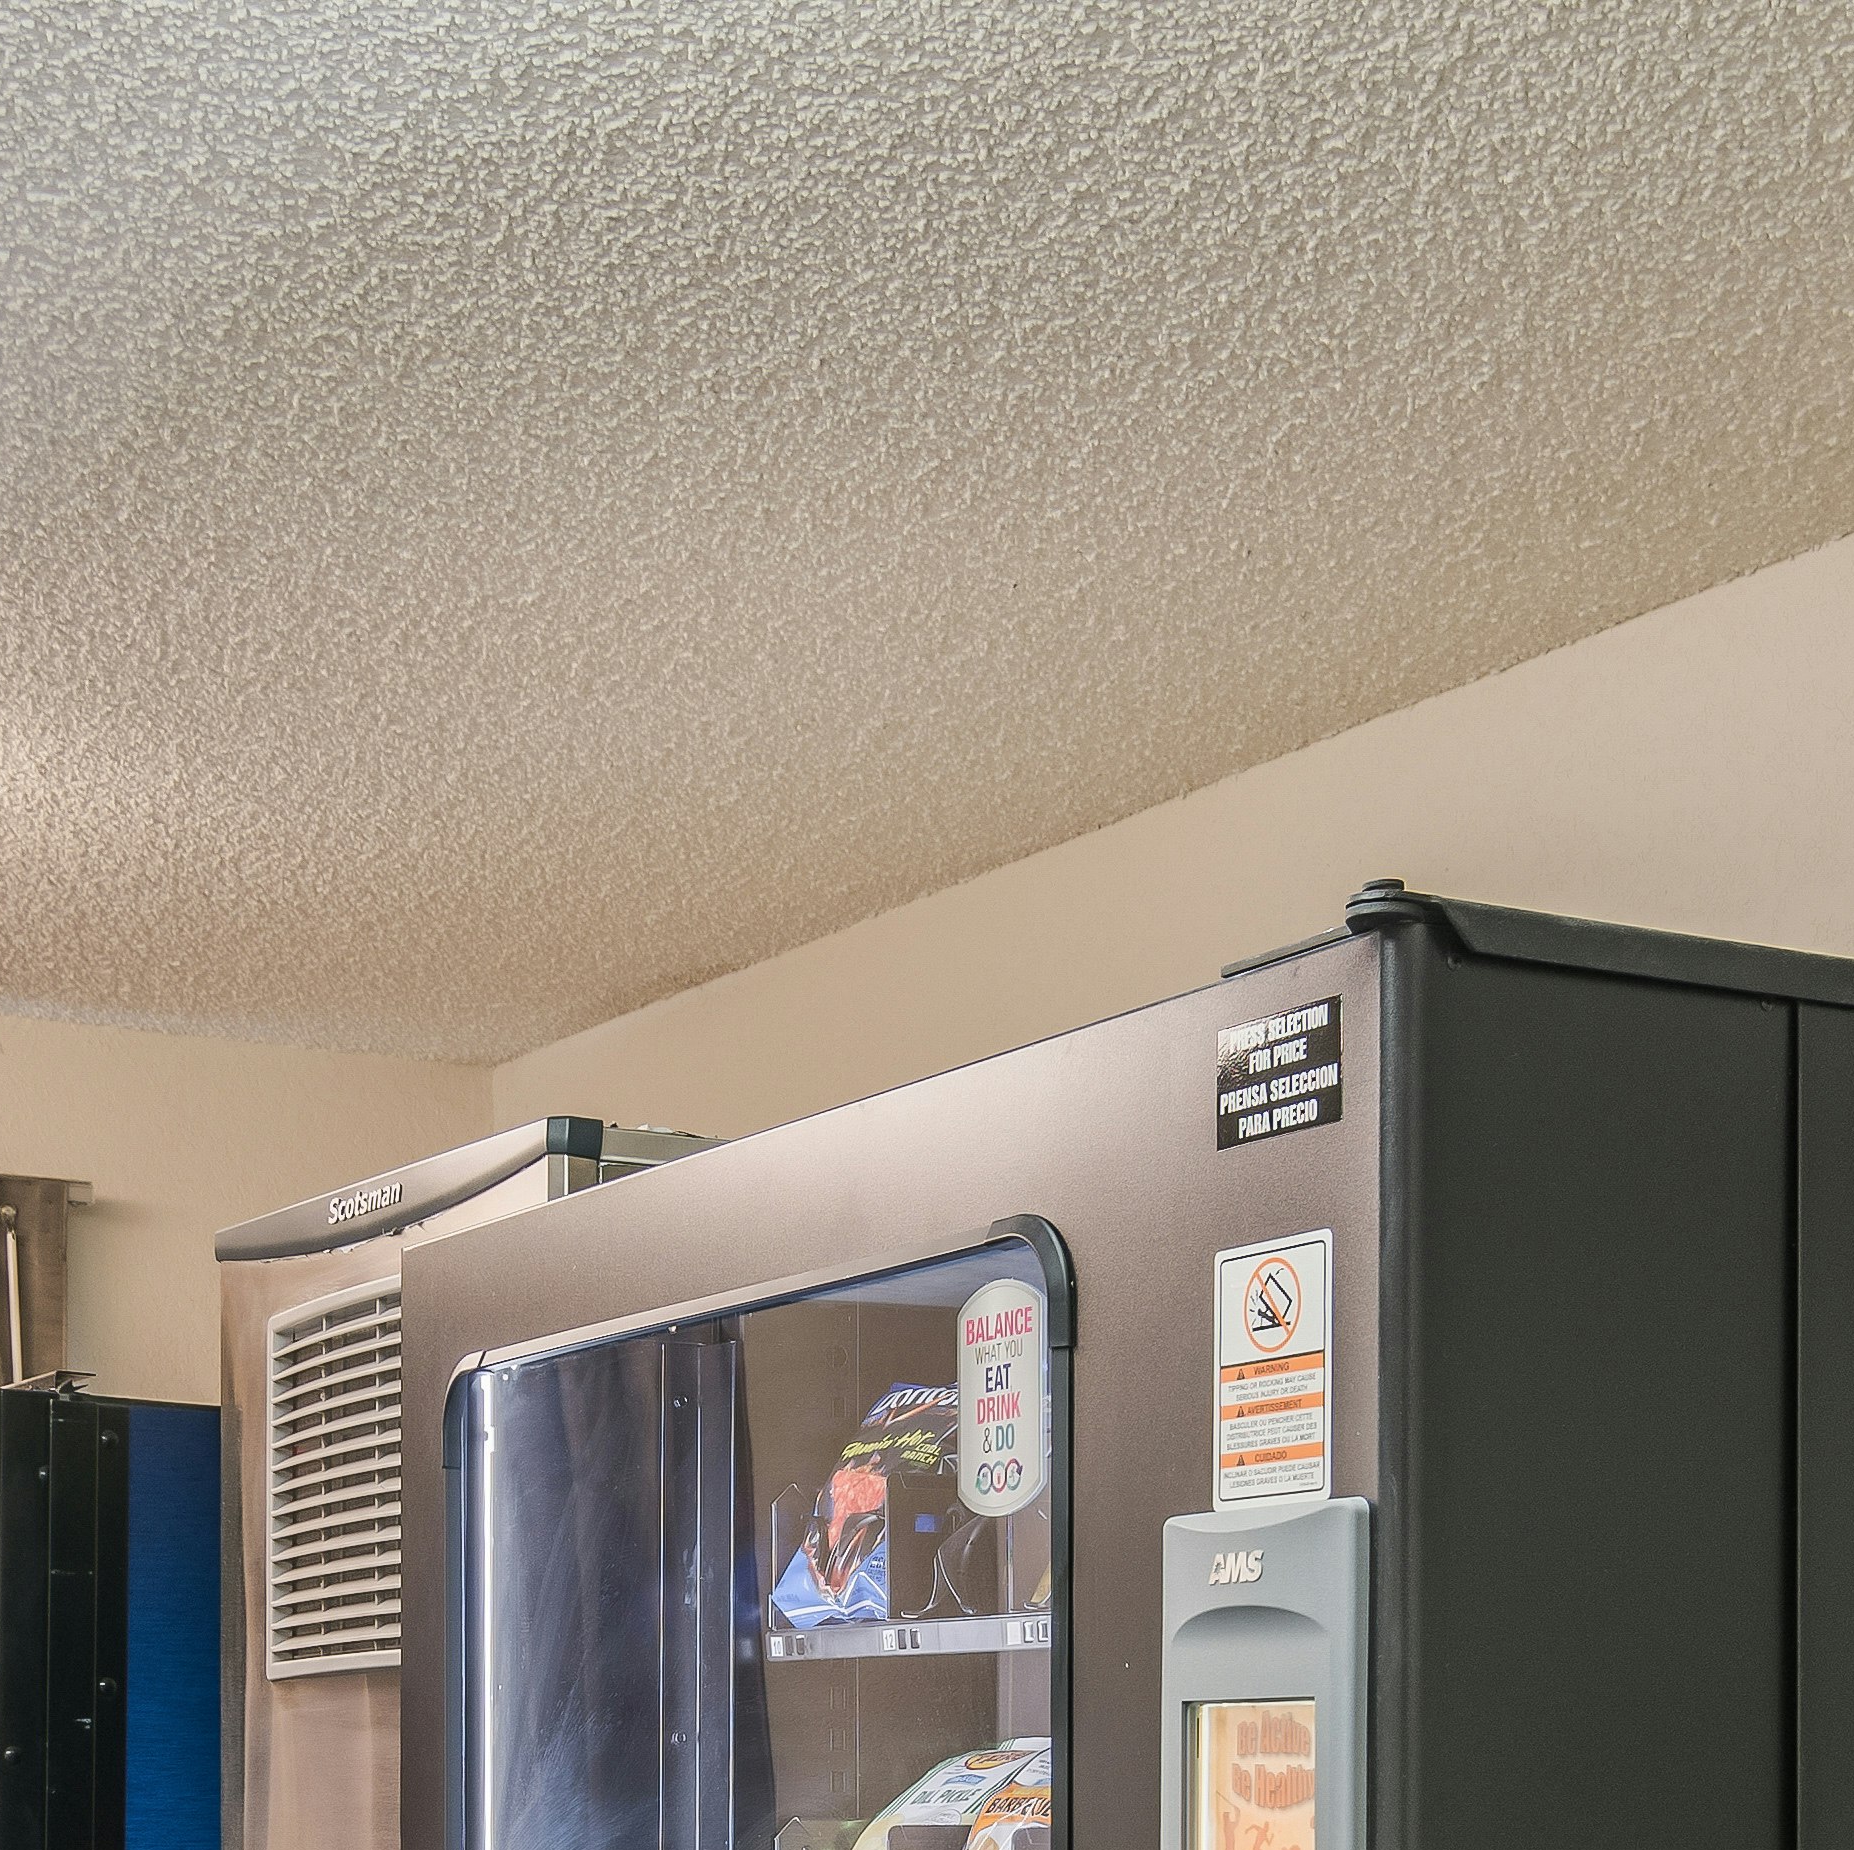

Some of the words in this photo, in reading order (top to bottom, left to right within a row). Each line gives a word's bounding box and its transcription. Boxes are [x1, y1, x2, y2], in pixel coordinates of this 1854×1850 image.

[1268, 1003, 1329, 1039] SELECTION
[1248, 1049, 1271, 1075] FOR
[1274, 1037, 1307, 1068] PRICE
[1220, 1083, 1268, 1116] PRENSA
[1270, 1063, 1338, 1102] SELECCION
[1238, 1111, 1270, 1139] PARA
[1273, 1099, 1318, 1130] PRECIO
[328, 1182, 402, 1225] Scotsman
[966, 1306, 1033, 1346] BALANCE
[975, 1343, 1002, 1365] WHAT
[1005, 1338, 1023, 1358] YOU
[1254, 1362, 1289, 1375] WARNING
[985, 1363, 1012, 1393] EAT
[977, 1392, 1021, 1425] DRINK
[1247, 1399, 1302, 1414] AVERTISSEMENT
[983, 1427, 992, 1454] &
[996, 1423, 1014, 1450] DO
[900, 1450, 938, 1465] RANCH
[1254, 1450, 1287, 1462] CUIDADO
[1208, 1549, 1265, 1586] AMS
[885, 1633, 894, 1647] 12
[1237, 1721, 1258, 1756] Be
[1260, 1710, 1311, 1757] Active
[1232, 1763, 1252, 1802] Be
